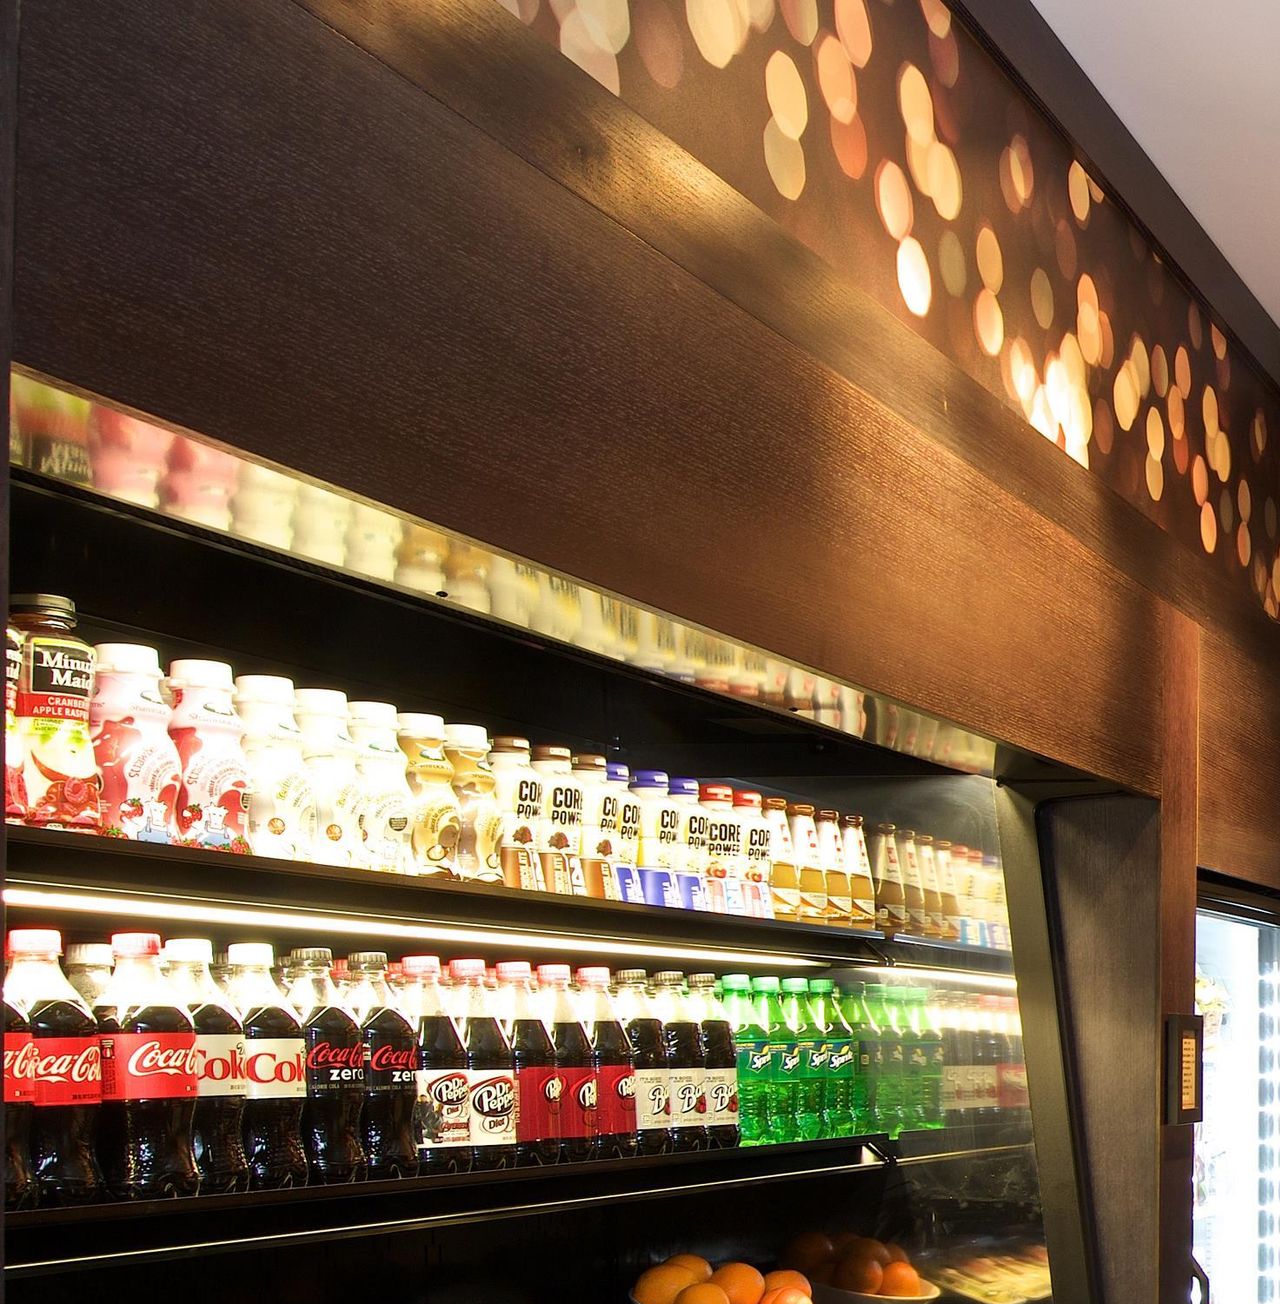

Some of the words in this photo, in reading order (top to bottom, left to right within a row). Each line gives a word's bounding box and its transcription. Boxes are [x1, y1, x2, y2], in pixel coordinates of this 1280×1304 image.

[33, 706, 63, 715] APPLE
[709, 823, 741, 842] CORE
[392, 1070, 416, 1083] zer
[489, 1117, 506, 1129] Diet
